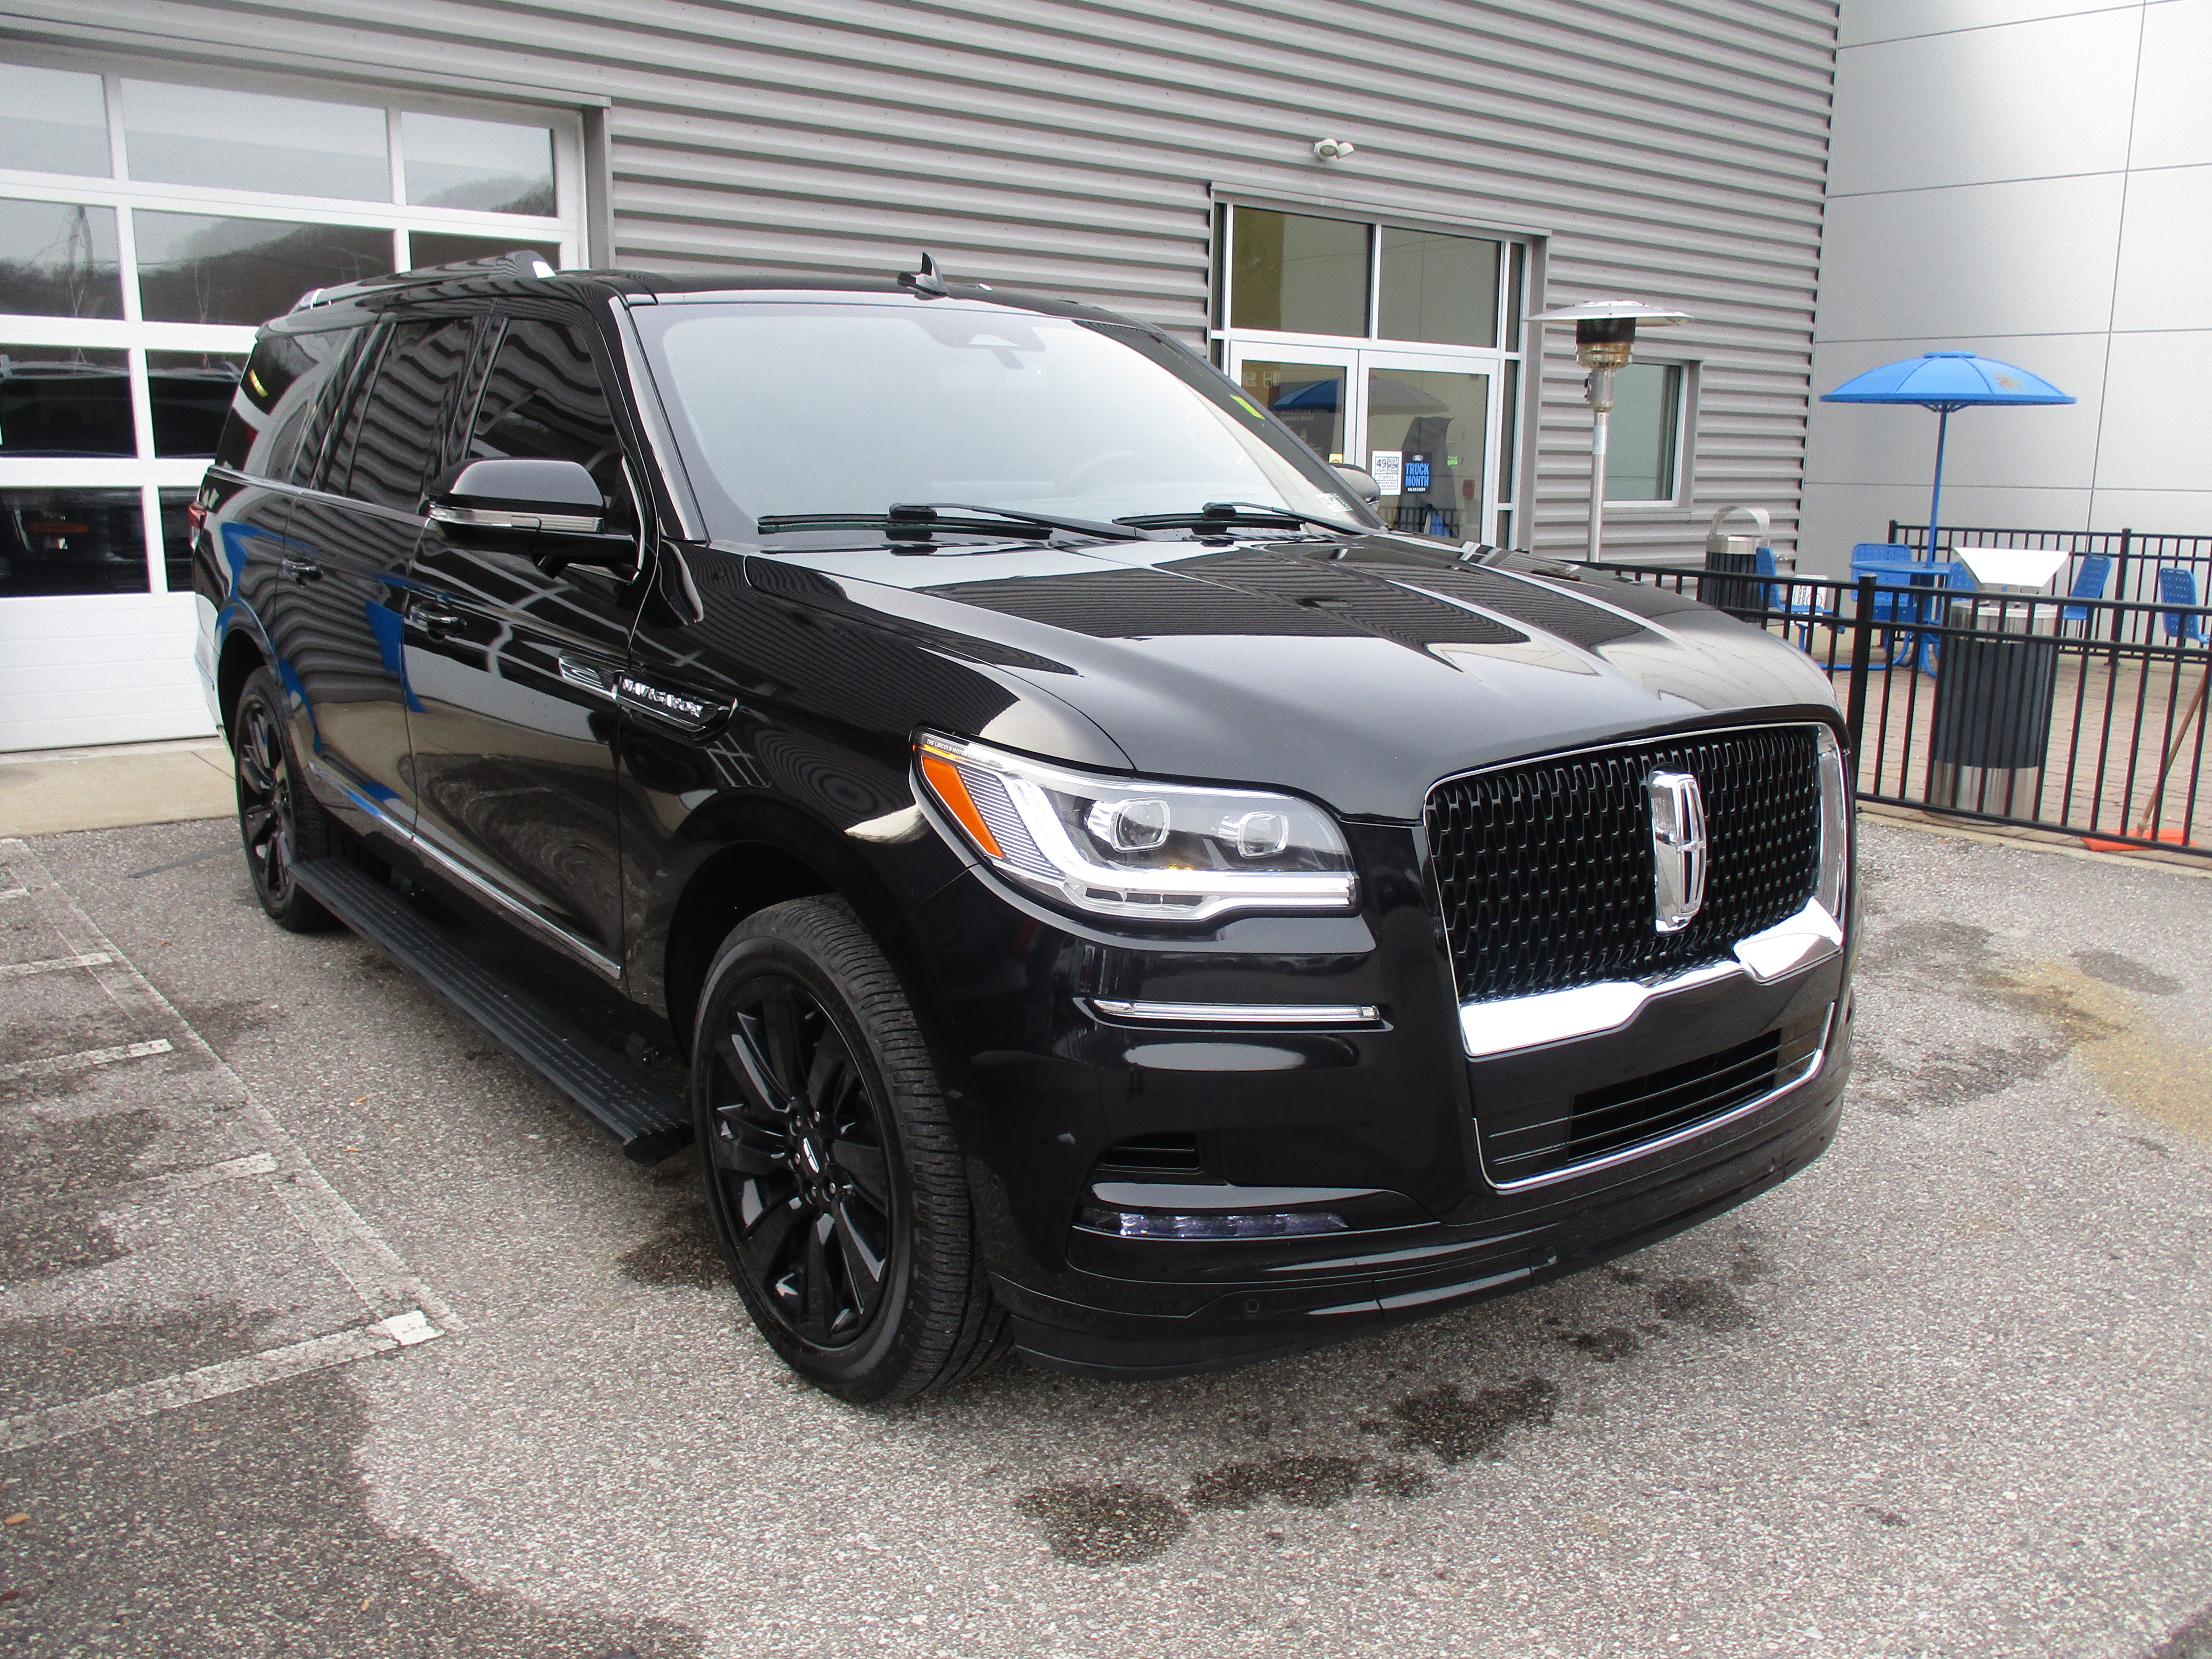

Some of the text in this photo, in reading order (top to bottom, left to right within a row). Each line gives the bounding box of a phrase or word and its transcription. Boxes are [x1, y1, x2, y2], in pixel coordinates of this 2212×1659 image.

[1376, 459, 1386, 468] 49
[1405, 463, 1429, 475] TRUCK
[1405, 476, 1429, 486] MONTH
[934, 741, 952, 752] LINCOLN
[952, 747, 967, 757] MOTOR
